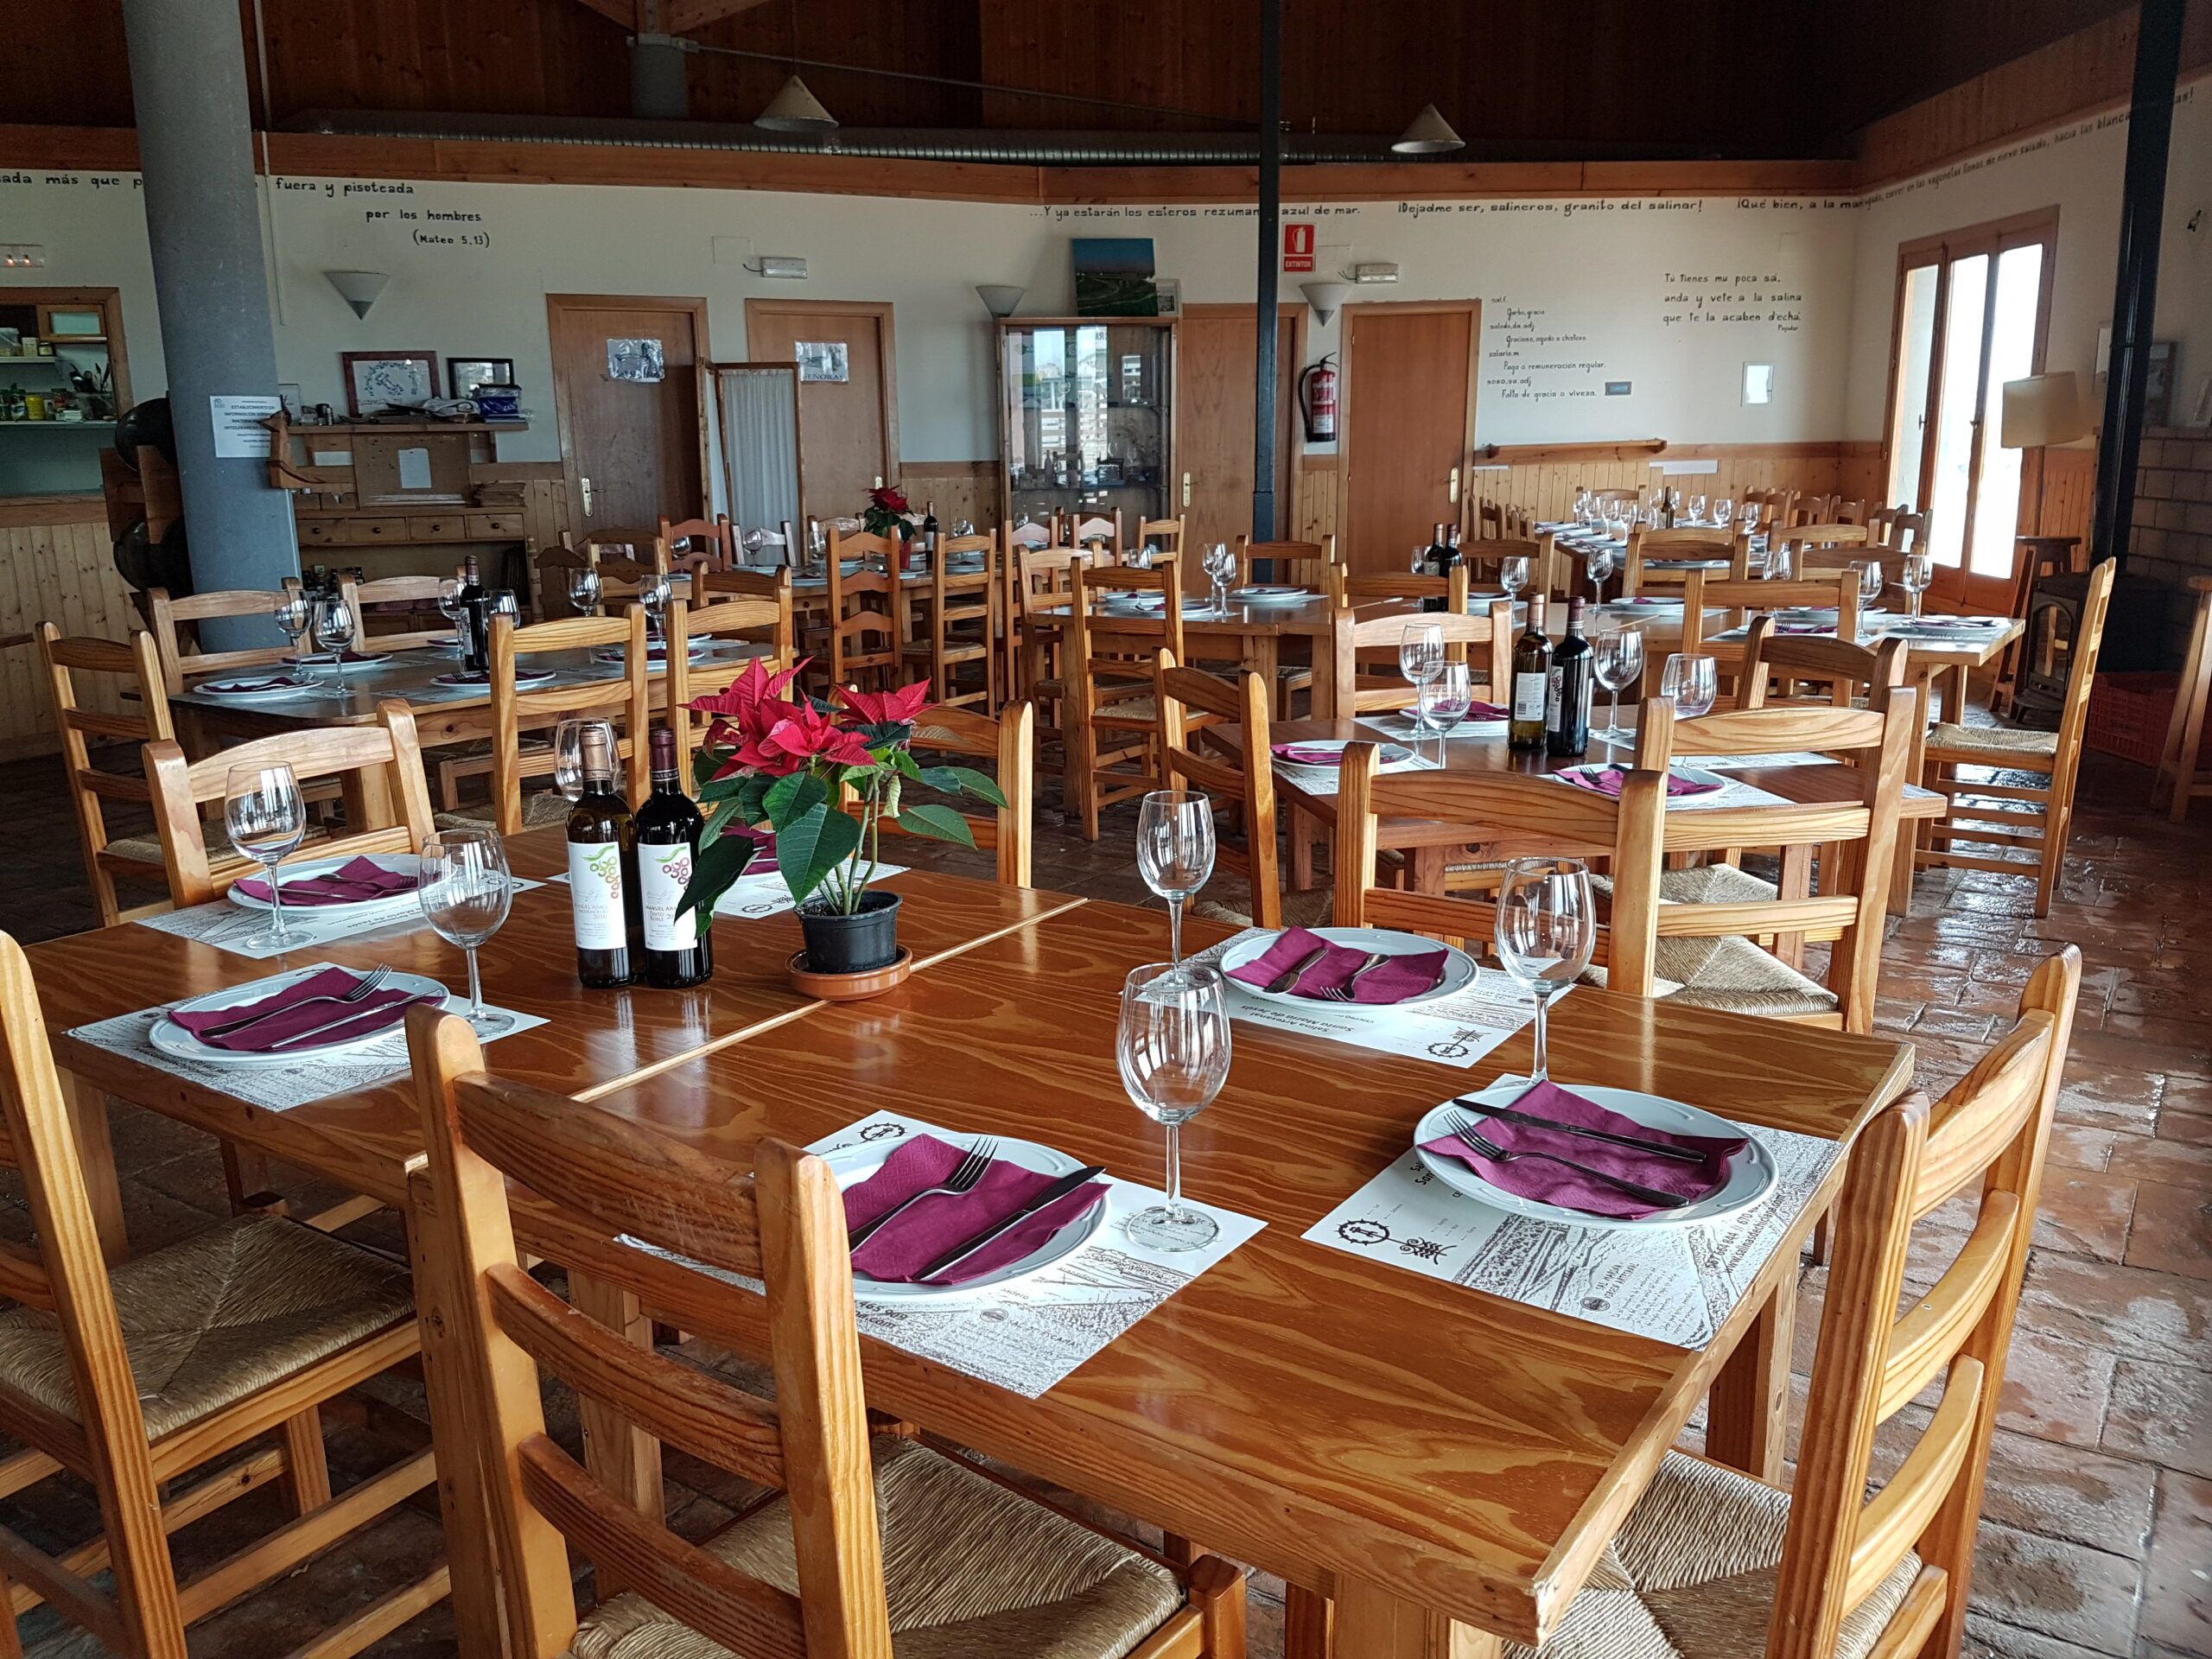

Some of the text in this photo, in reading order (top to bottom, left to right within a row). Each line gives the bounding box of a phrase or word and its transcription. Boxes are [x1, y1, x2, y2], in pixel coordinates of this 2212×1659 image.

[0, 171, 33, 184] ada
[46, 174, 79, 185] más
[91, 177, 120, 189] que
[276, 177, 316, 190] fuera
[325, 182, 335, 197] y
[344, 182, 415, 197] pisoteada
[1459, 204, 1484, 213] ser,
[1564, 200, 1615, 217] granito
[1621, 200, 1643, 211] del
[1649, 200, 1704, 213] salinar!
[1773, 199, 1804, 210] bien,
[1824, 200, 1835, 208] la
[365, 209, 482, 223] por los hombres
[1056, 209, 1070, 221] ya
[1074, 206, 1121, 217] estarán
[1125, 207, 1142, 217] los
[1147, 206, 1197, 216] esteros
[1205, 207, 1261, 216] rezuman
[1281, 206, 1310, 215] azul
[1314, 205, 1331, 215] de
[1285, 260, 1313, 269] EXTINTOR
[1735, 276, 1758, 287] poca
[1664, 292, 1689, 302] anda
[1695, 296, 1703, 308] y
[1710, 292, 1733, 302] vete
[1754, 292, 1764, 302] la
[1770, 292, 1802, 302] salina
[1662, 314, 1682, 327] que
[1689, 312, 1700, 322] te
[1707, 312, 1716, 322] la
[1722, 311, 1762, 322] acaben
[1503, 360, 1519, 374] Paga
[1528, 361, 1577, 370] remuneración
[1522, 389, 1531, 398] de
[1534, 391, 1557, 403] gracia
[1299, 1022, 1329, 1033] Salina
[1321, 1020, 1356, 1033] Santa
